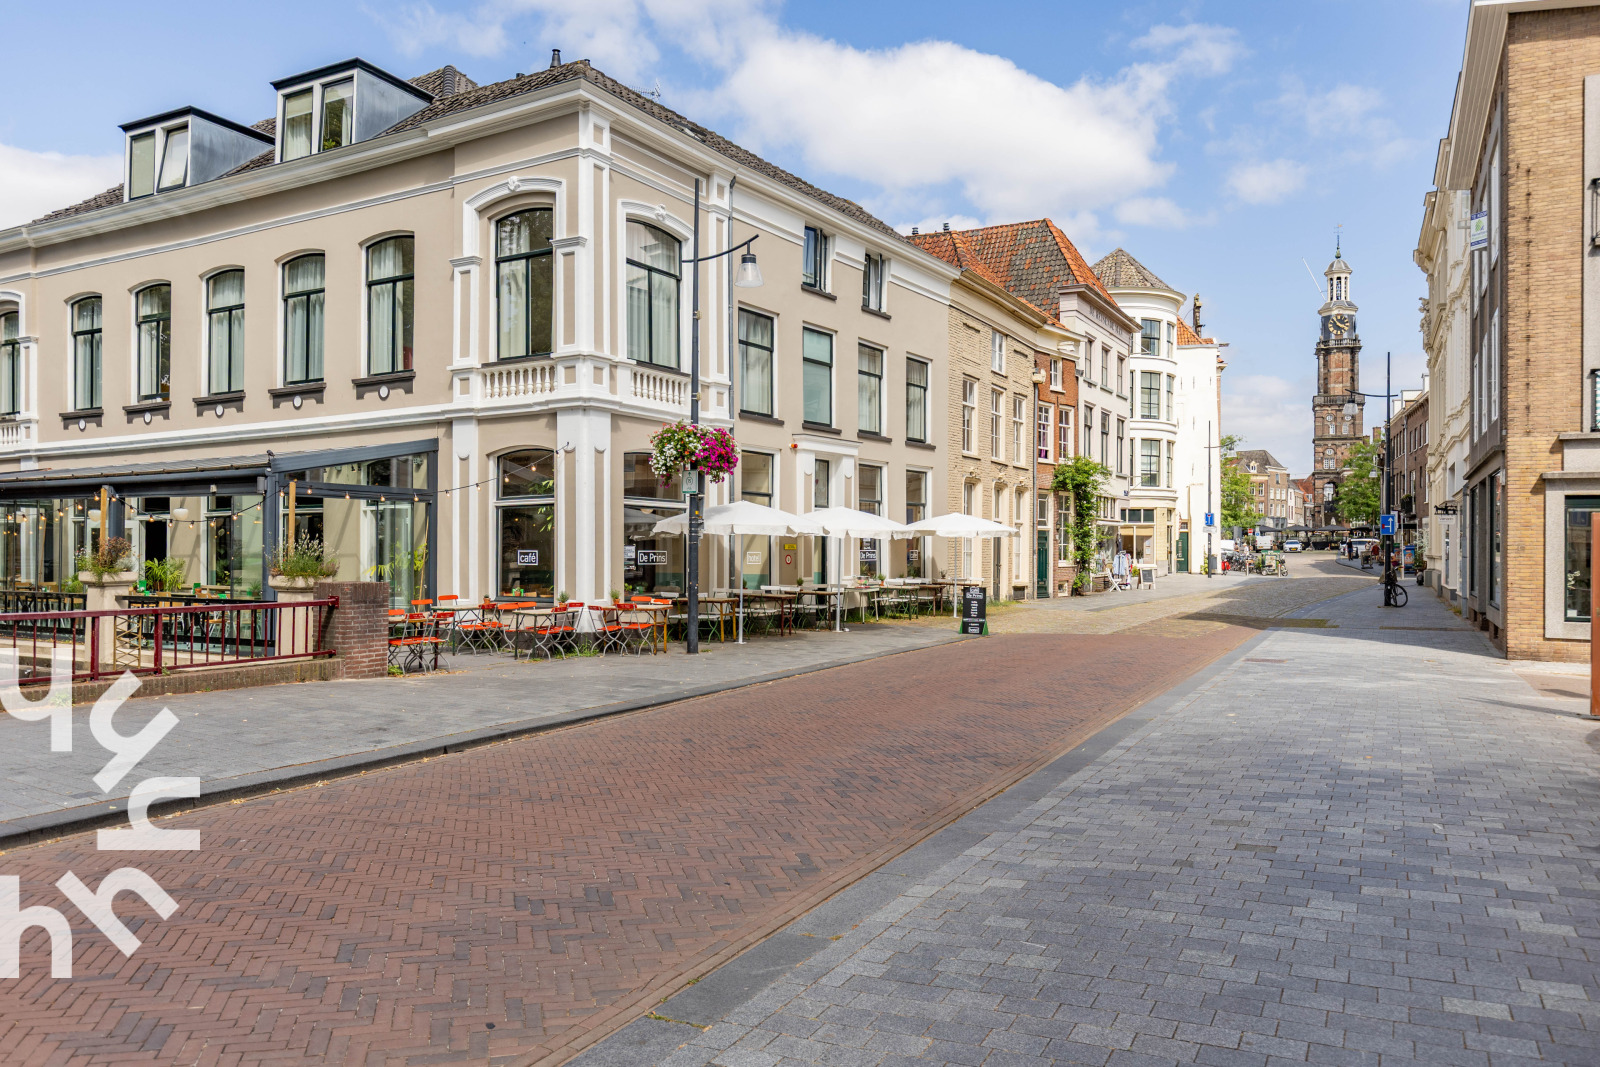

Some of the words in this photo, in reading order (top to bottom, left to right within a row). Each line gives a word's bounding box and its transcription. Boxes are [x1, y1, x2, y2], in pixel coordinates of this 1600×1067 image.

[520, 552, 536, 563] café
[640, 552, 648, 562] De
[650, 552, 666, 562] Prins
[748, 554, 760, 562] hotel
[866, 551, 876, 559] Prins
